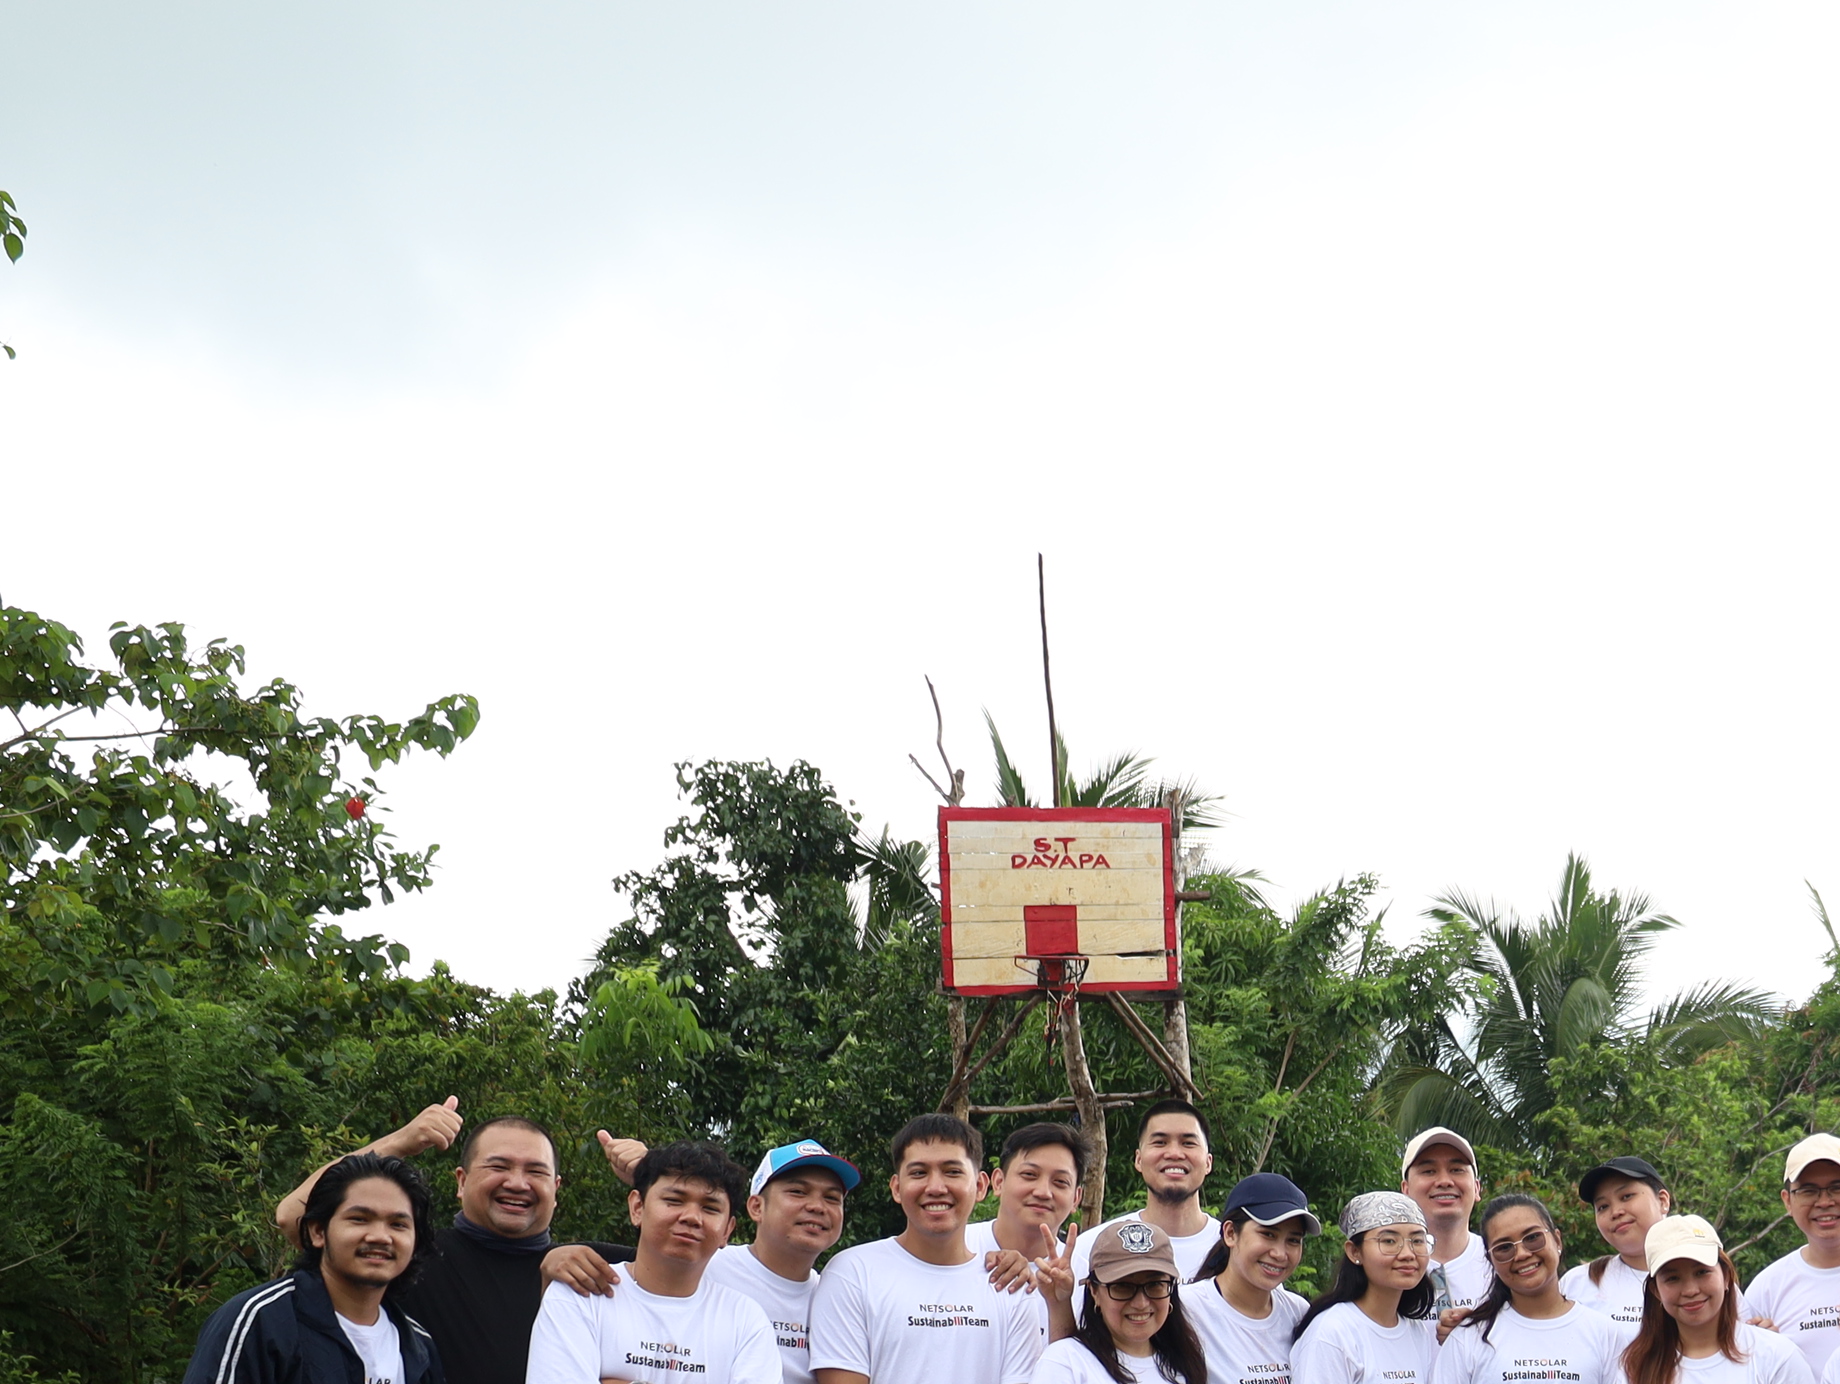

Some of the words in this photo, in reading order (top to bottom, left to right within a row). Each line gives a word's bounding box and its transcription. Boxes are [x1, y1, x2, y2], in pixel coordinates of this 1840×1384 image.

[1011, 854, 1111, 869] DAYAPA
[919, 1304, 974, 1314] NETSOLAR
[1514, 1359, 1567, 1367] NETSOLAR
[1382, 1371, 1416, 1380] NETSOLAR
